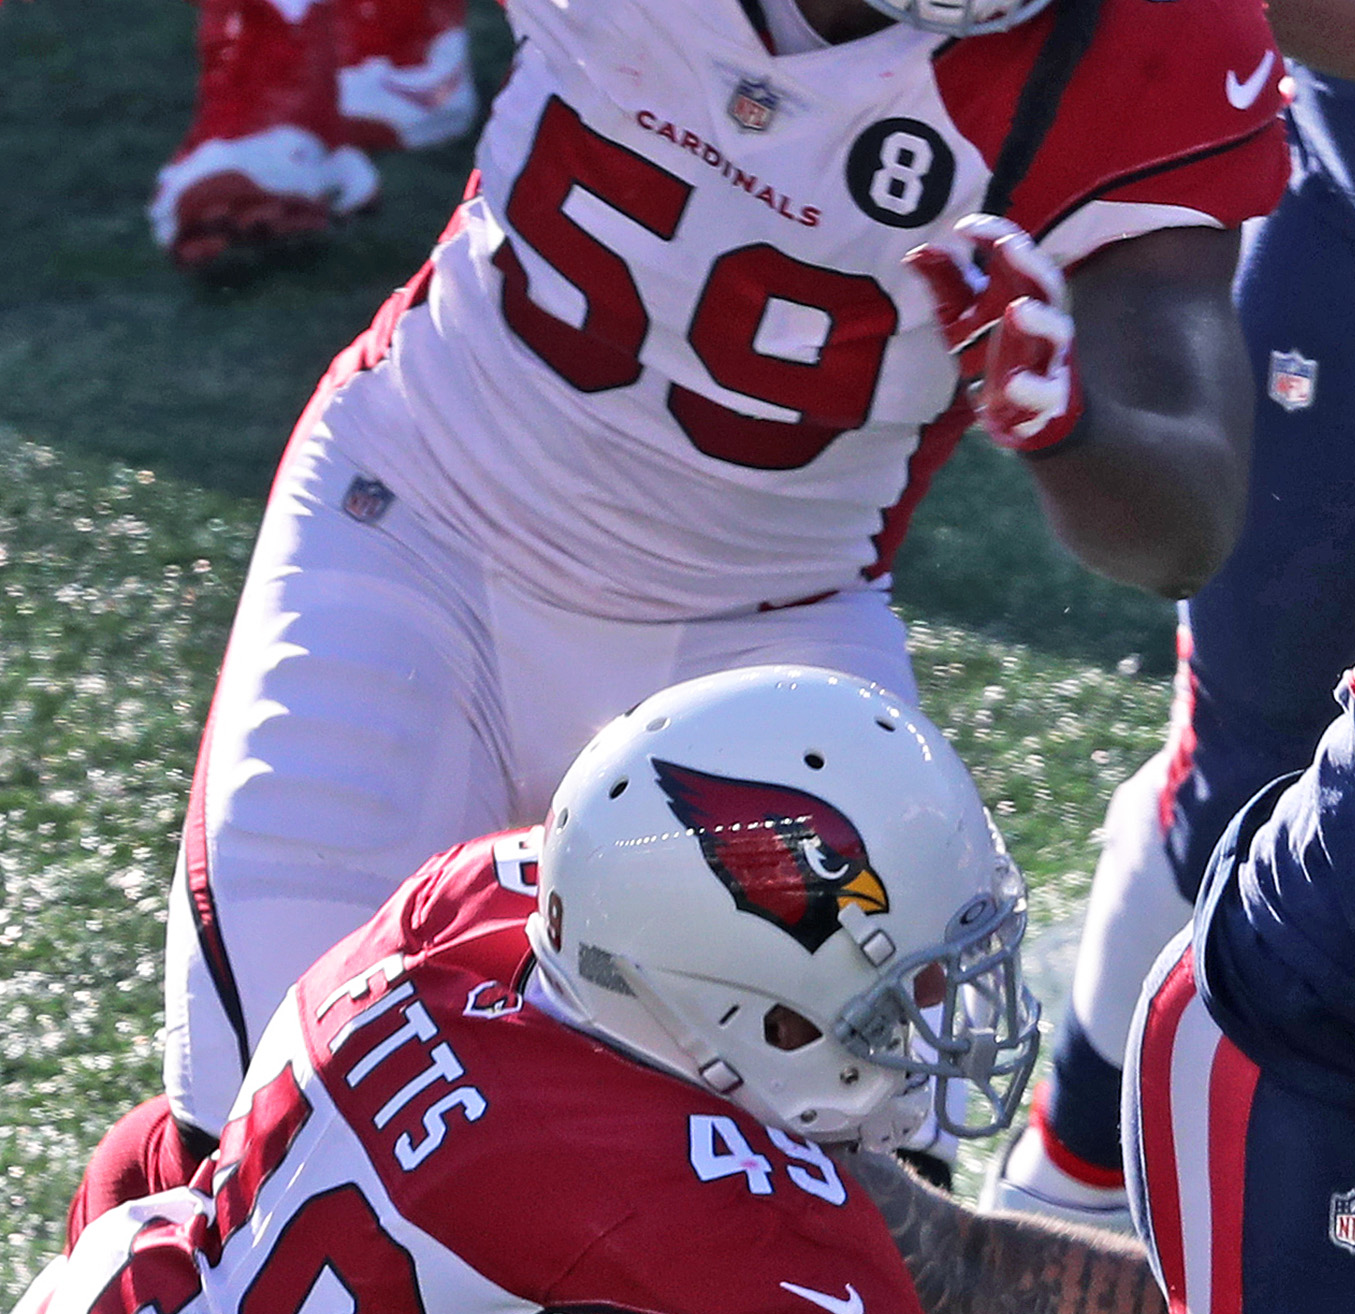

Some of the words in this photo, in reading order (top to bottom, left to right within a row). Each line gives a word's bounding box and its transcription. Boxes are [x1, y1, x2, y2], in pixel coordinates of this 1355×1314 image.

[636, 109, 823, 228] CARDINALS
[868, 130, 935, 217] 8
[491, 93, 899, 471] 59
[687, 1113, 848, 1208] 49
